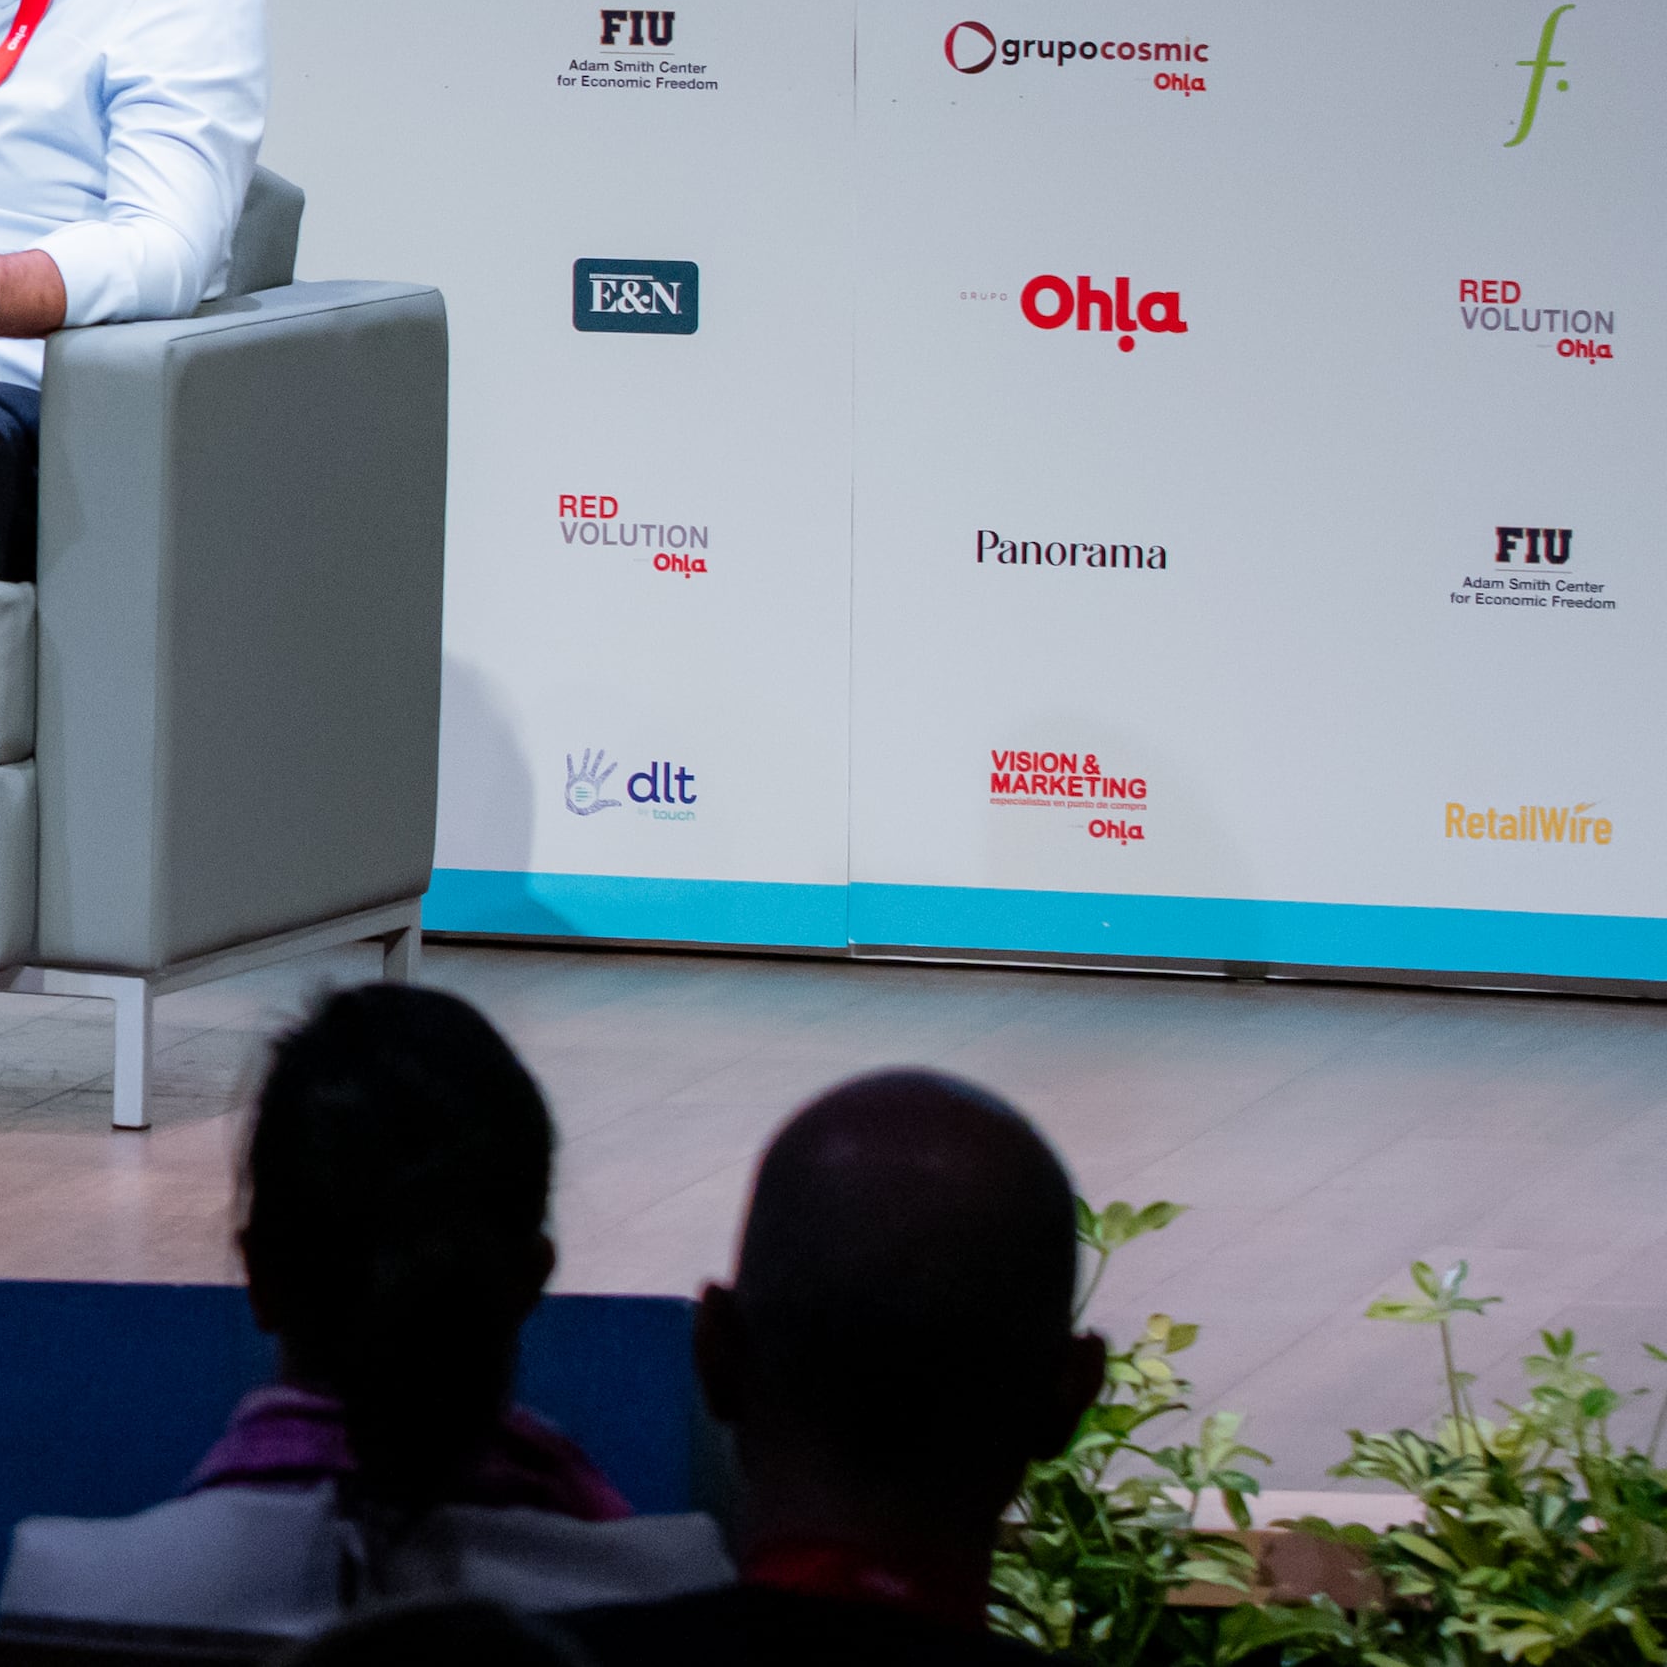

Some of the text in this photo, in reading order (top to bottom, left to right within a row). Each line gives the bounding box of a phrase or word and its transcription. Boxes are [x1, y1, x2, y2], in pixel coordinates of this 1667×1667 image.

[601, 10, 675, 46] FIU
[1001, 34, 1209, 66] grupocosmic
[1154, 72, 1206, 97] Ohla
[590, 279, 682, 314] E&N
[1460, 279, 1521, 304] RED
[959, 274, 1188, 353] GRUPO Ohla
[1461, 303, 1614, 334] VOLUTION
[1556, 338, 1614, 365] Ohla
[559, 494, 618, 519] RED
[560, 518, 708, 549] VOLUTION
[1496, 527, 1572, 565] FIU
[977, 530, 1166, 569] Panorama
[653, 553, 708, 579] Ohla
[991, 750, 1102, 775] VISION &
[627, 761, 697, 804] dlt
[991, 774, 1147, 798] MARKETING
[652, 809, 696, 821] touch
[1445, 802, 1612, 845] RetailWire
[1088, 819, 1145, 846] Ohla
